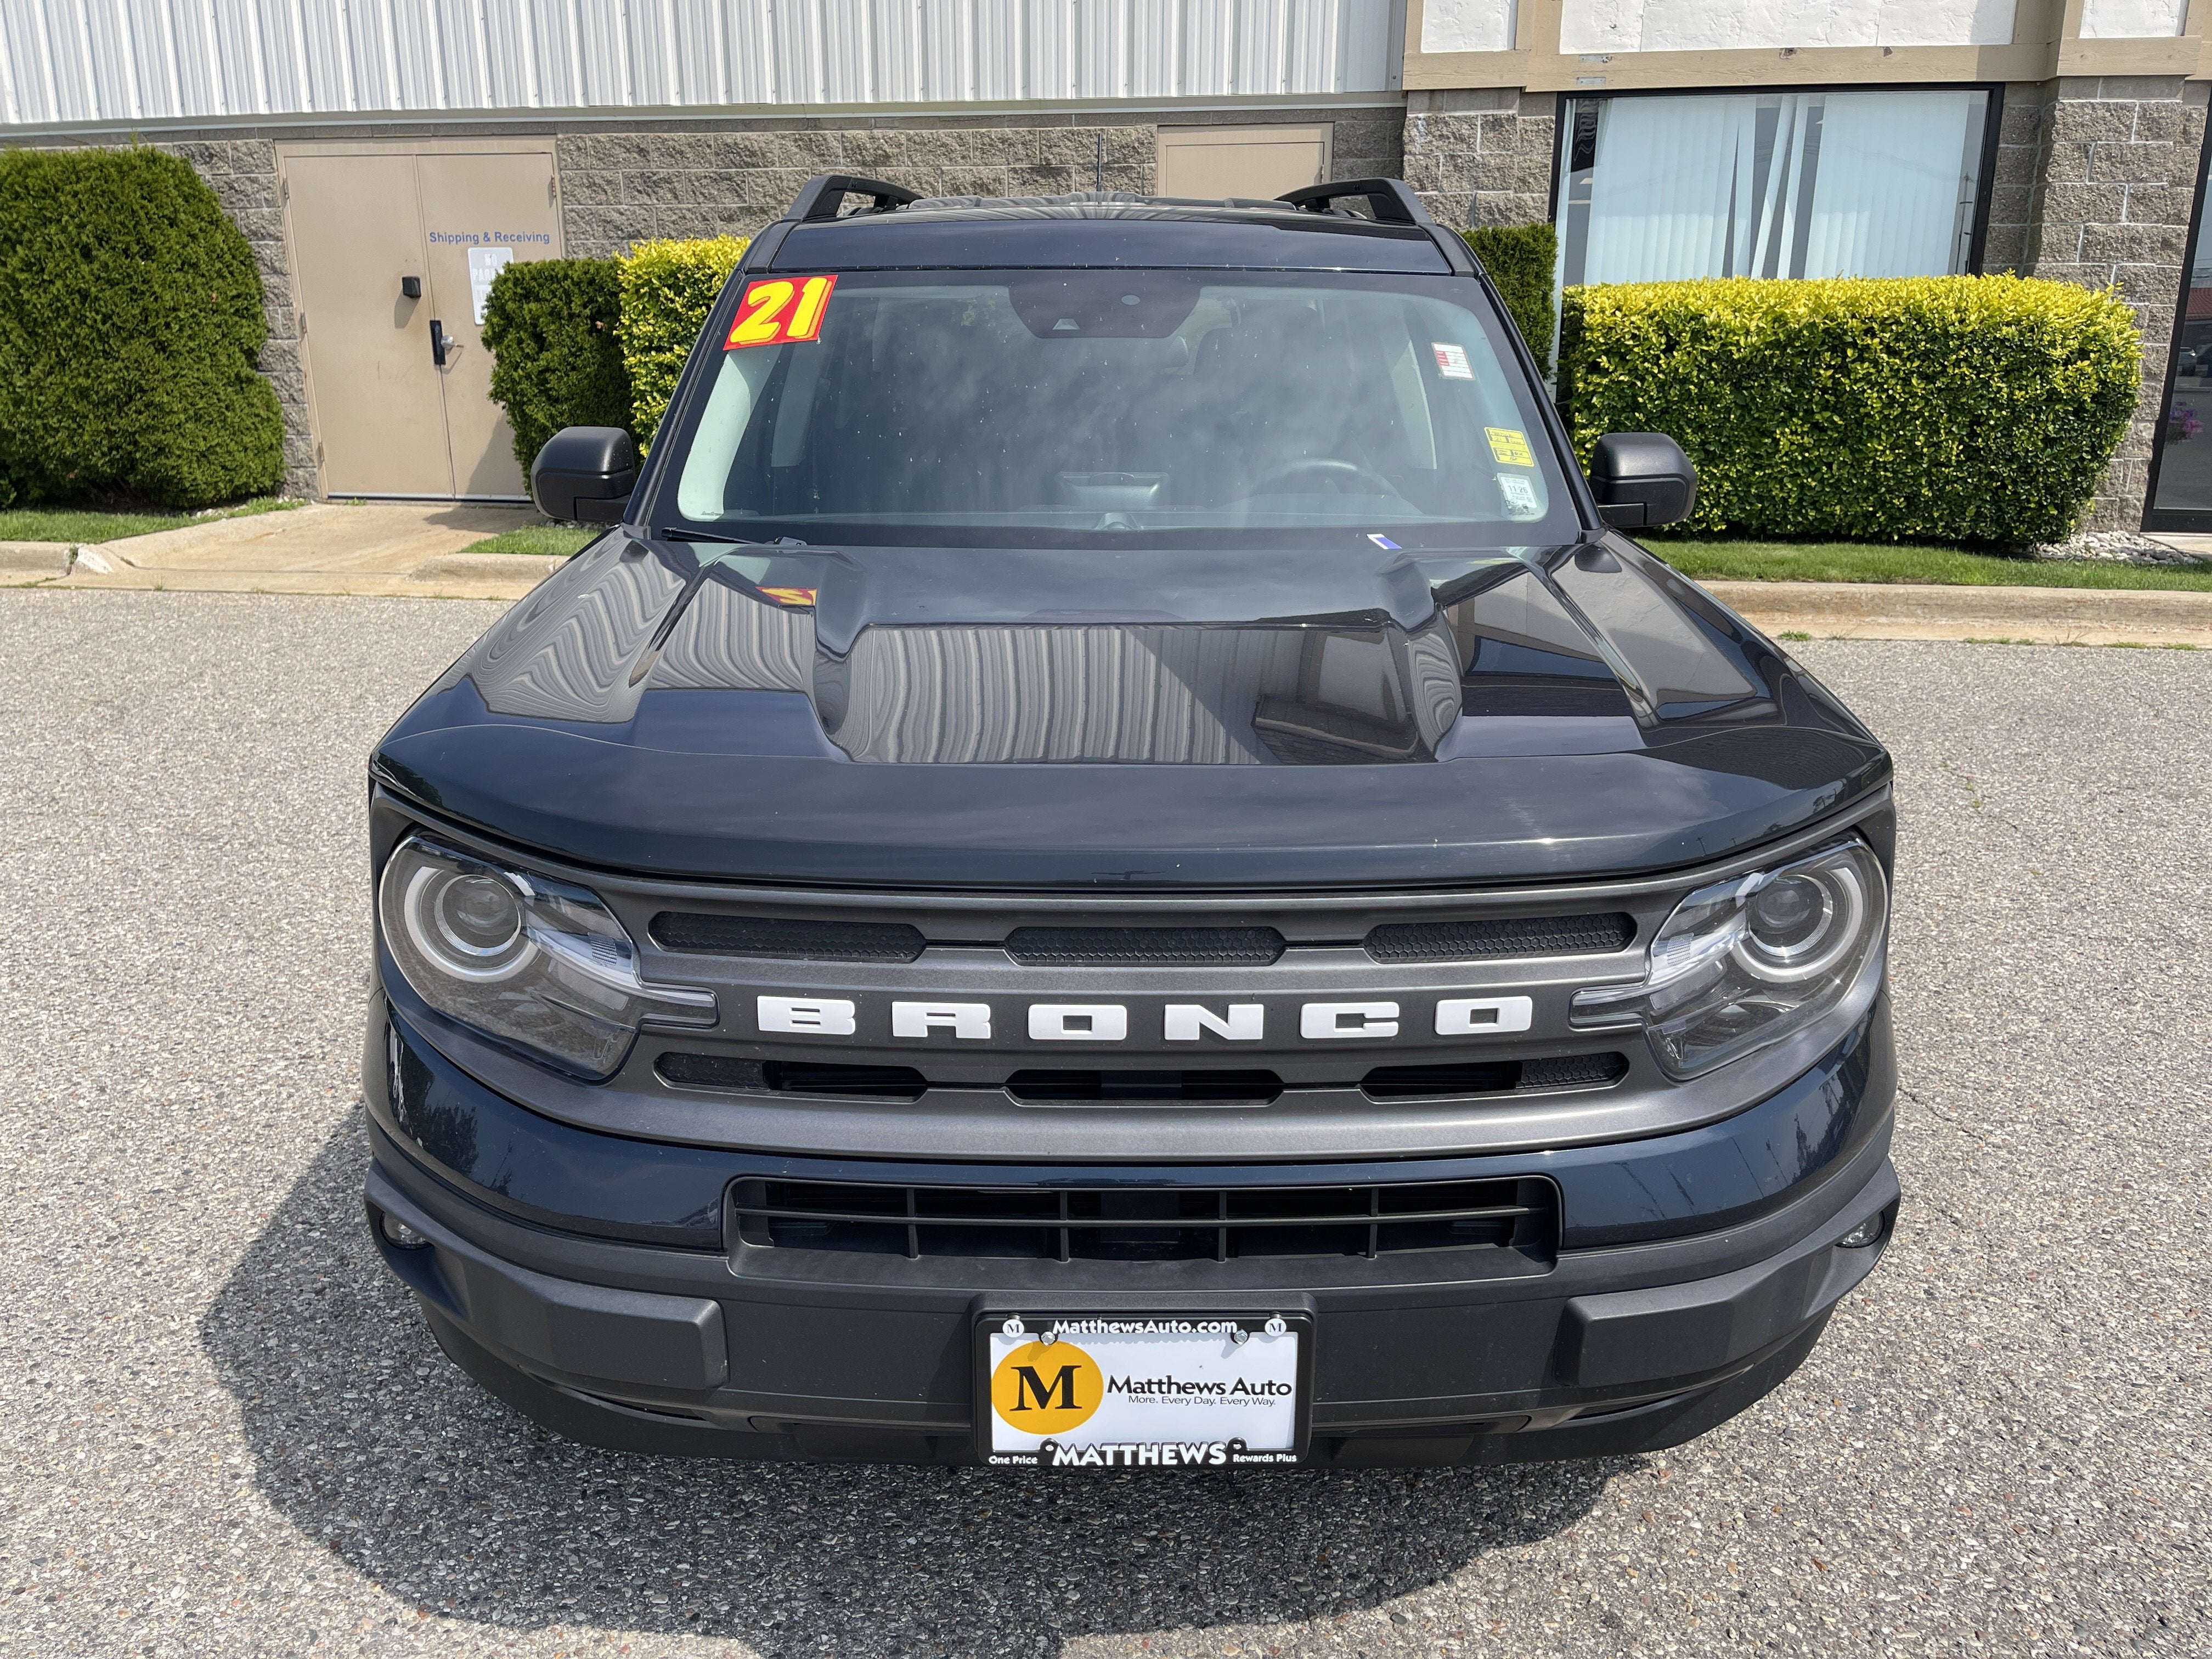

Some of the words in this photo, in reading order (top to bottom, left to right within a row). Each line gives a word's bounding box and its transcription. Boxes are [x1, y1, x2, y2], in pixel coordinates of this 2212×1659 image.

[430, 232, 479, 245] Shipping
[483, 232, 490, 242] &
[494, 232, 550, 245] Receiving
[730, 278, 832, 345] 21
[757, 995, 1533, 1040] BRONCO
[1007, 1324, 1020, 1334] M
[1052, 1319, 1238, 1334] MatthewsAuto.com
[1269, 1323, 1282, 1333] M
[1009, 1365, 1082, 1412] M
[1107, 1374, 1226, 1395] Matthews
[1229, 1376, 1292, 1396] Auto
[1128, 1395, 1158, 1404] More.
[1161, 1396, 1192, 1406] Every
[1220, 1397, 1250, 1407] Every
[988, 1455, 1010, 1464] One
[1012, 1455, 1038, 1464] Price
[1052, 1443, 1227, 1466] MATTHEWS
[1233, 1454, 1274, 1463] Rewards
[1276, 1454, 1297, 1463] Plus
